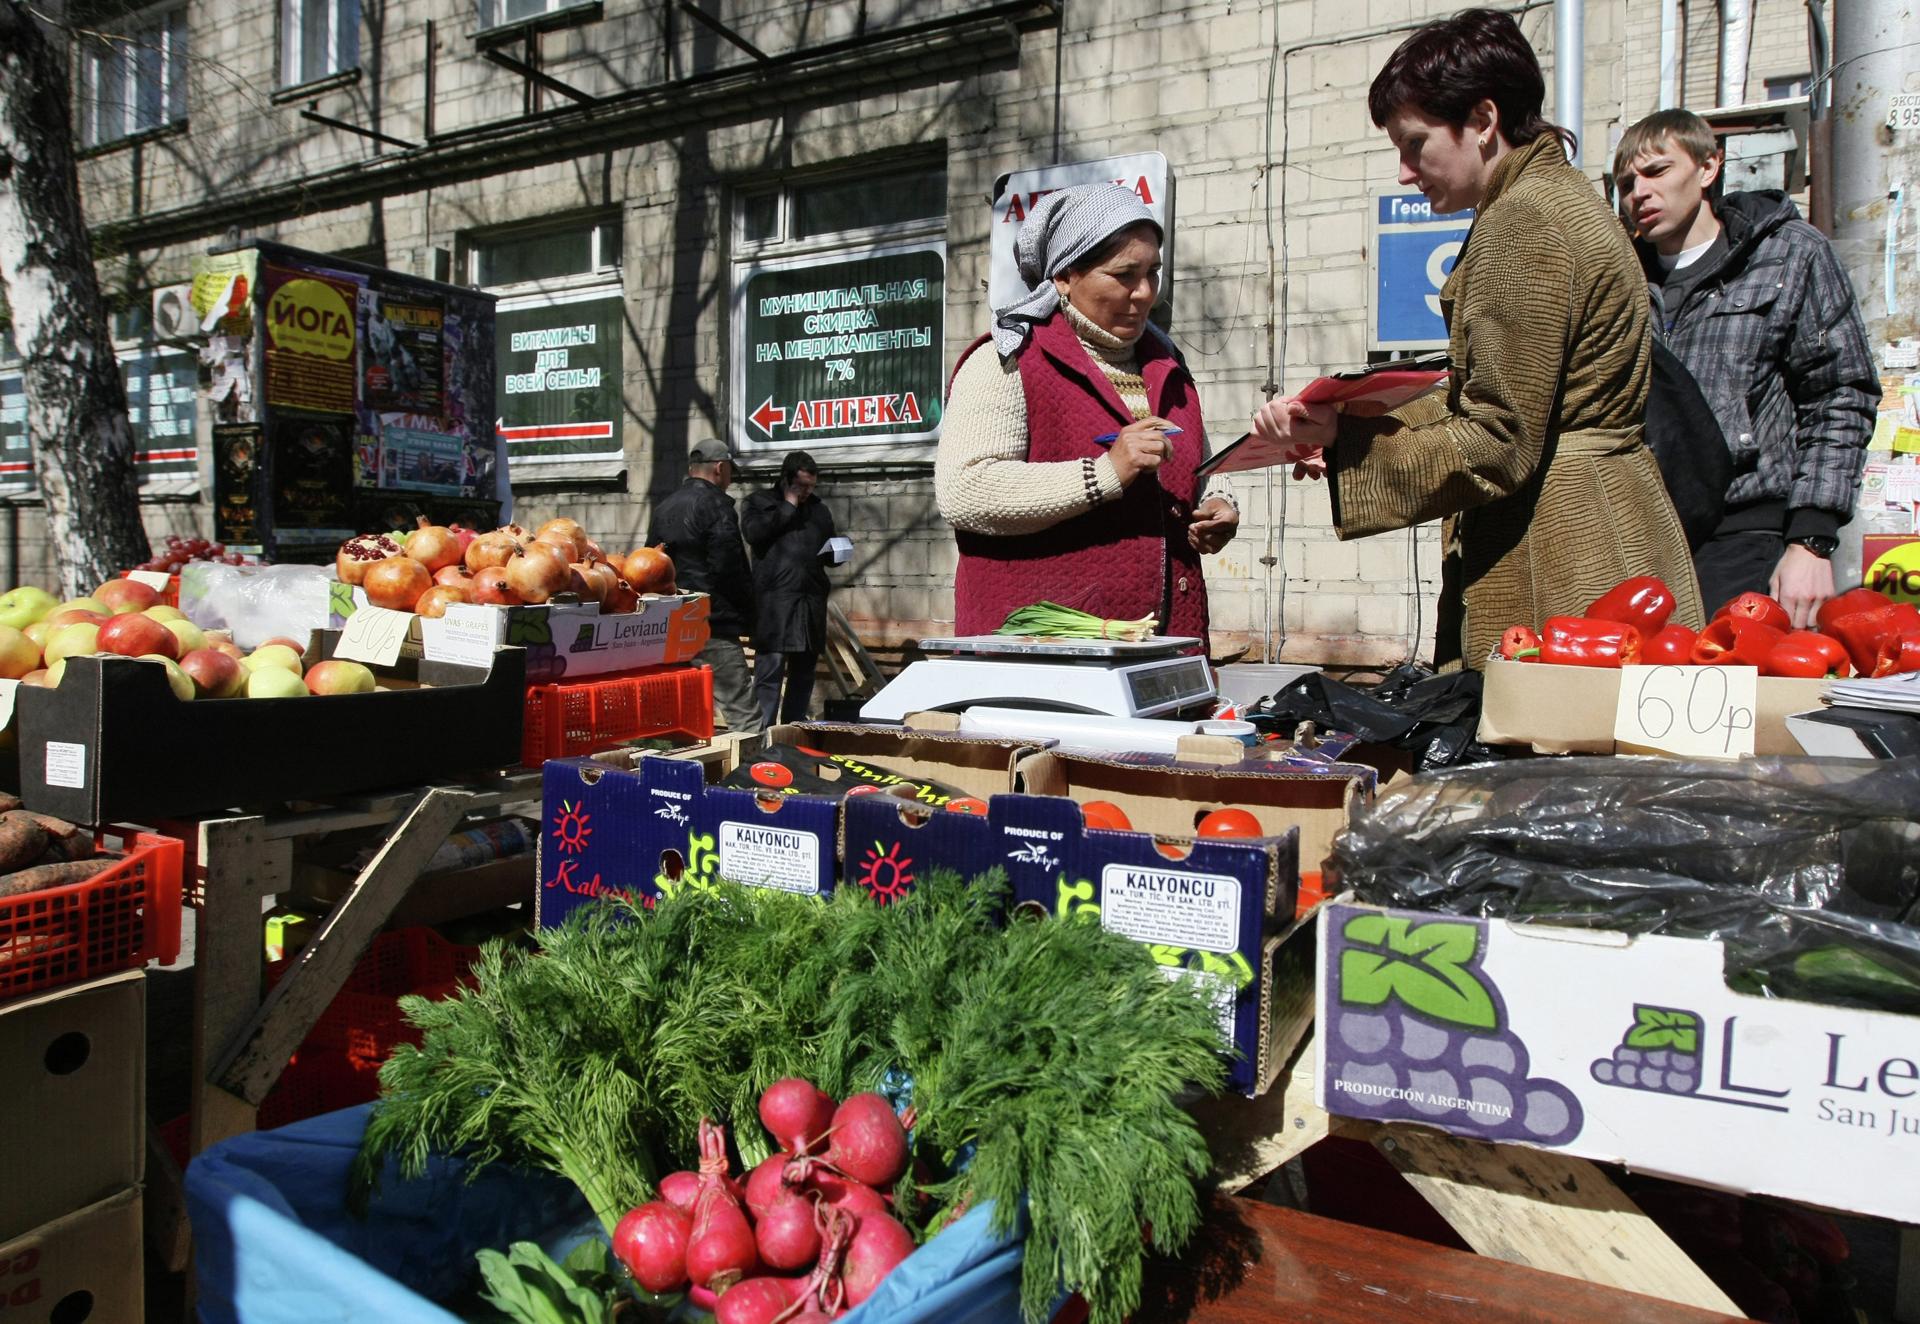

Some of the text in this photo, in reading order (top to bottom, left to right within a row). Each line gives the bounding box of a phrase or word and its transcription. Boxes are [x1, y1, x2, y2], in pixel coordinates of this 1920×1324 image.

[1889, 109, 1897, 127] 8
[760, 279, 928, 317] МУНИЦИПАЛЬНАЯ
[804, 309, 879, 334] СКИДКА
[511, 324, 596, 352] ВИТАМИНЫ
[756, 327, 931, 362] НА МЕДИКАМЕНТЫ
[535, 349, 568, 372] ДЛЯ
[825, 358, 856, 381] 7%
[505, 367, 600, 394] ВСЕЙ СЕМЬИ
[789, 392, 922, 431] АПТЕКА
[1638, 665, 1753, 754] 60р
[650, 788, 681, 799] PRODUCE
[736, 828, 800, 849] KALYONCU
[1004, 826, 1064, 841] PRODUCE OF
[1126, 872, 1215, 898] KALYONCU
[1334, 1079, 1513, 1118] PRODUCCIÓN ARGENTINA
[1817, 1098, 1920, 1137] San Ju
